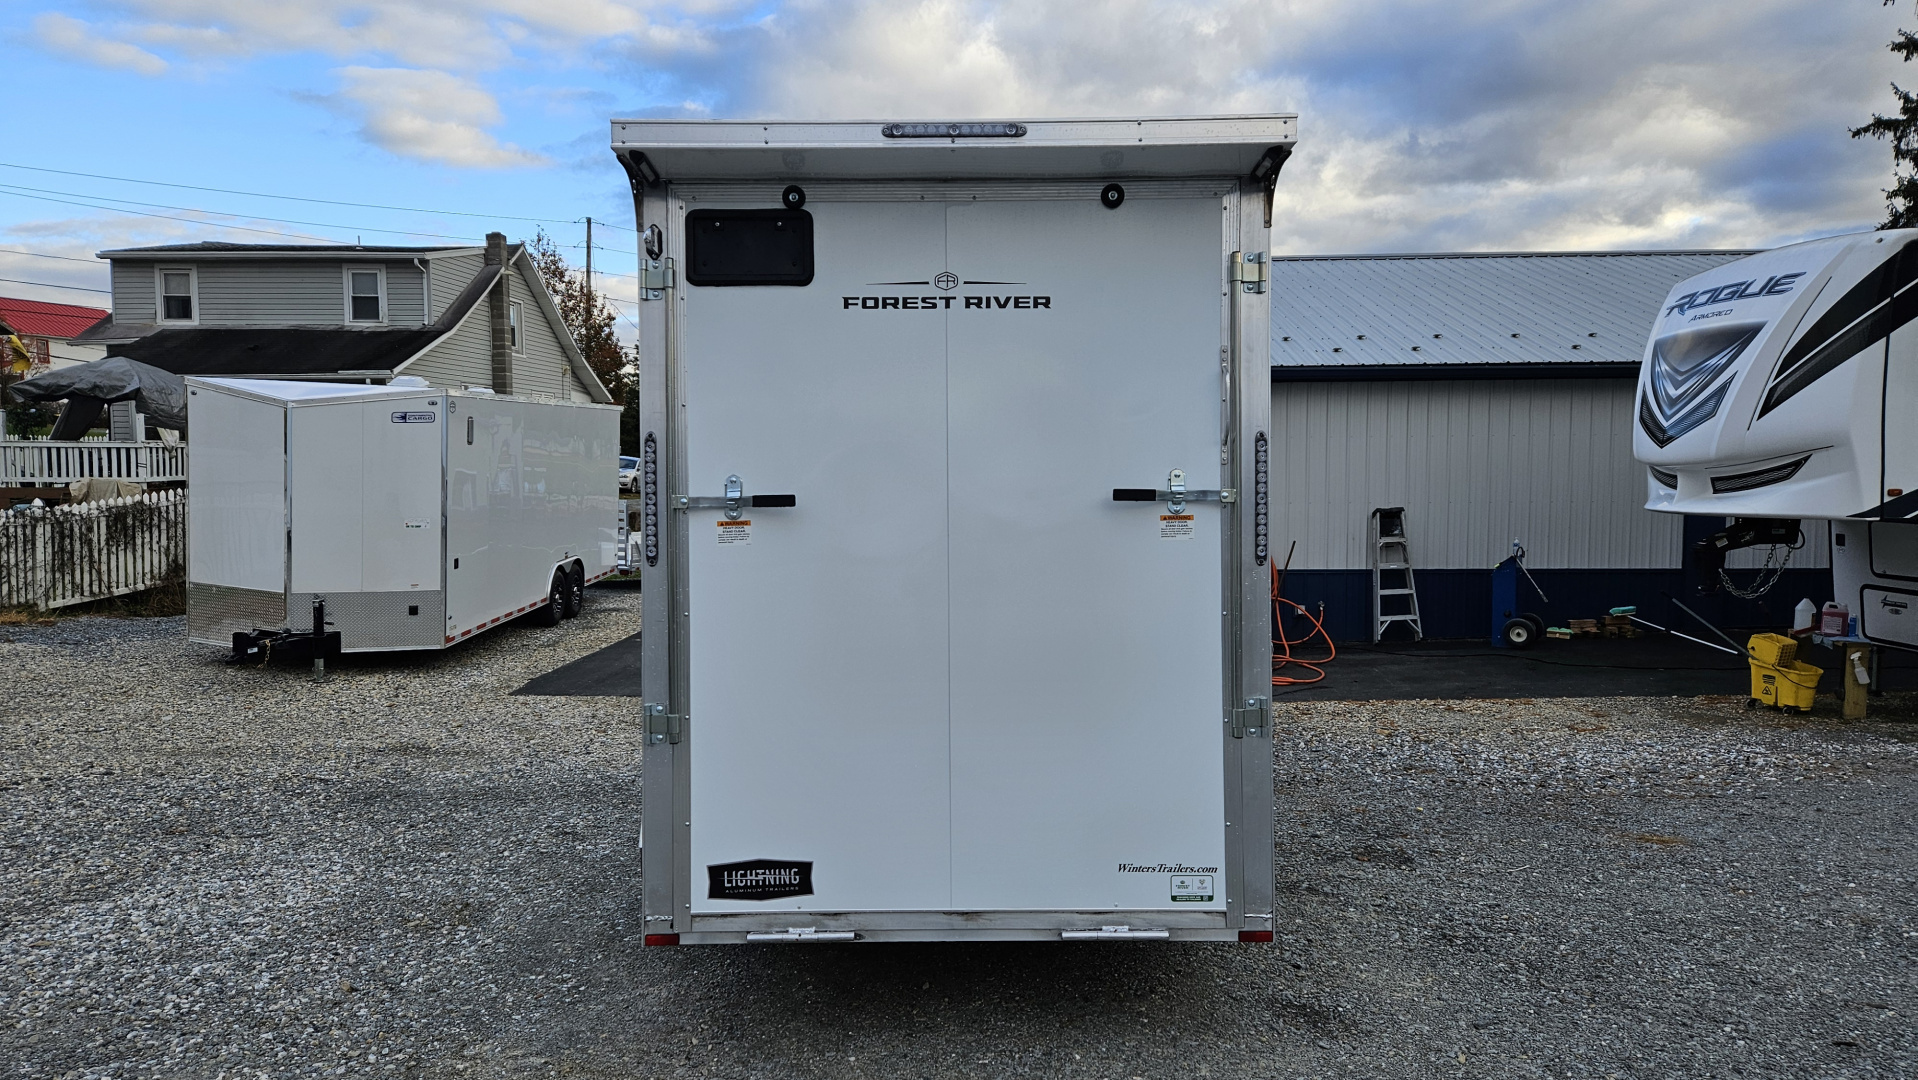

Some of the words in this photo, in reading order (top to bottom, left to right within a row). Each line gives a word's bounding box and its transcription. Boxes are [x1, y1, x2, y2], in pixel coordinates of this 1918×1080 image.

[842, 296, 957, 309] FOREST
[963, 296, 1051, 309] RIVER
[1664, 271, 1806, 318] ROGUE
[1688, 308, 1734, 324] ARMORED
[1117, 863, 1218, 874] WintersTrailers.com
[724, 868, 800, 887] LIGHTNING
